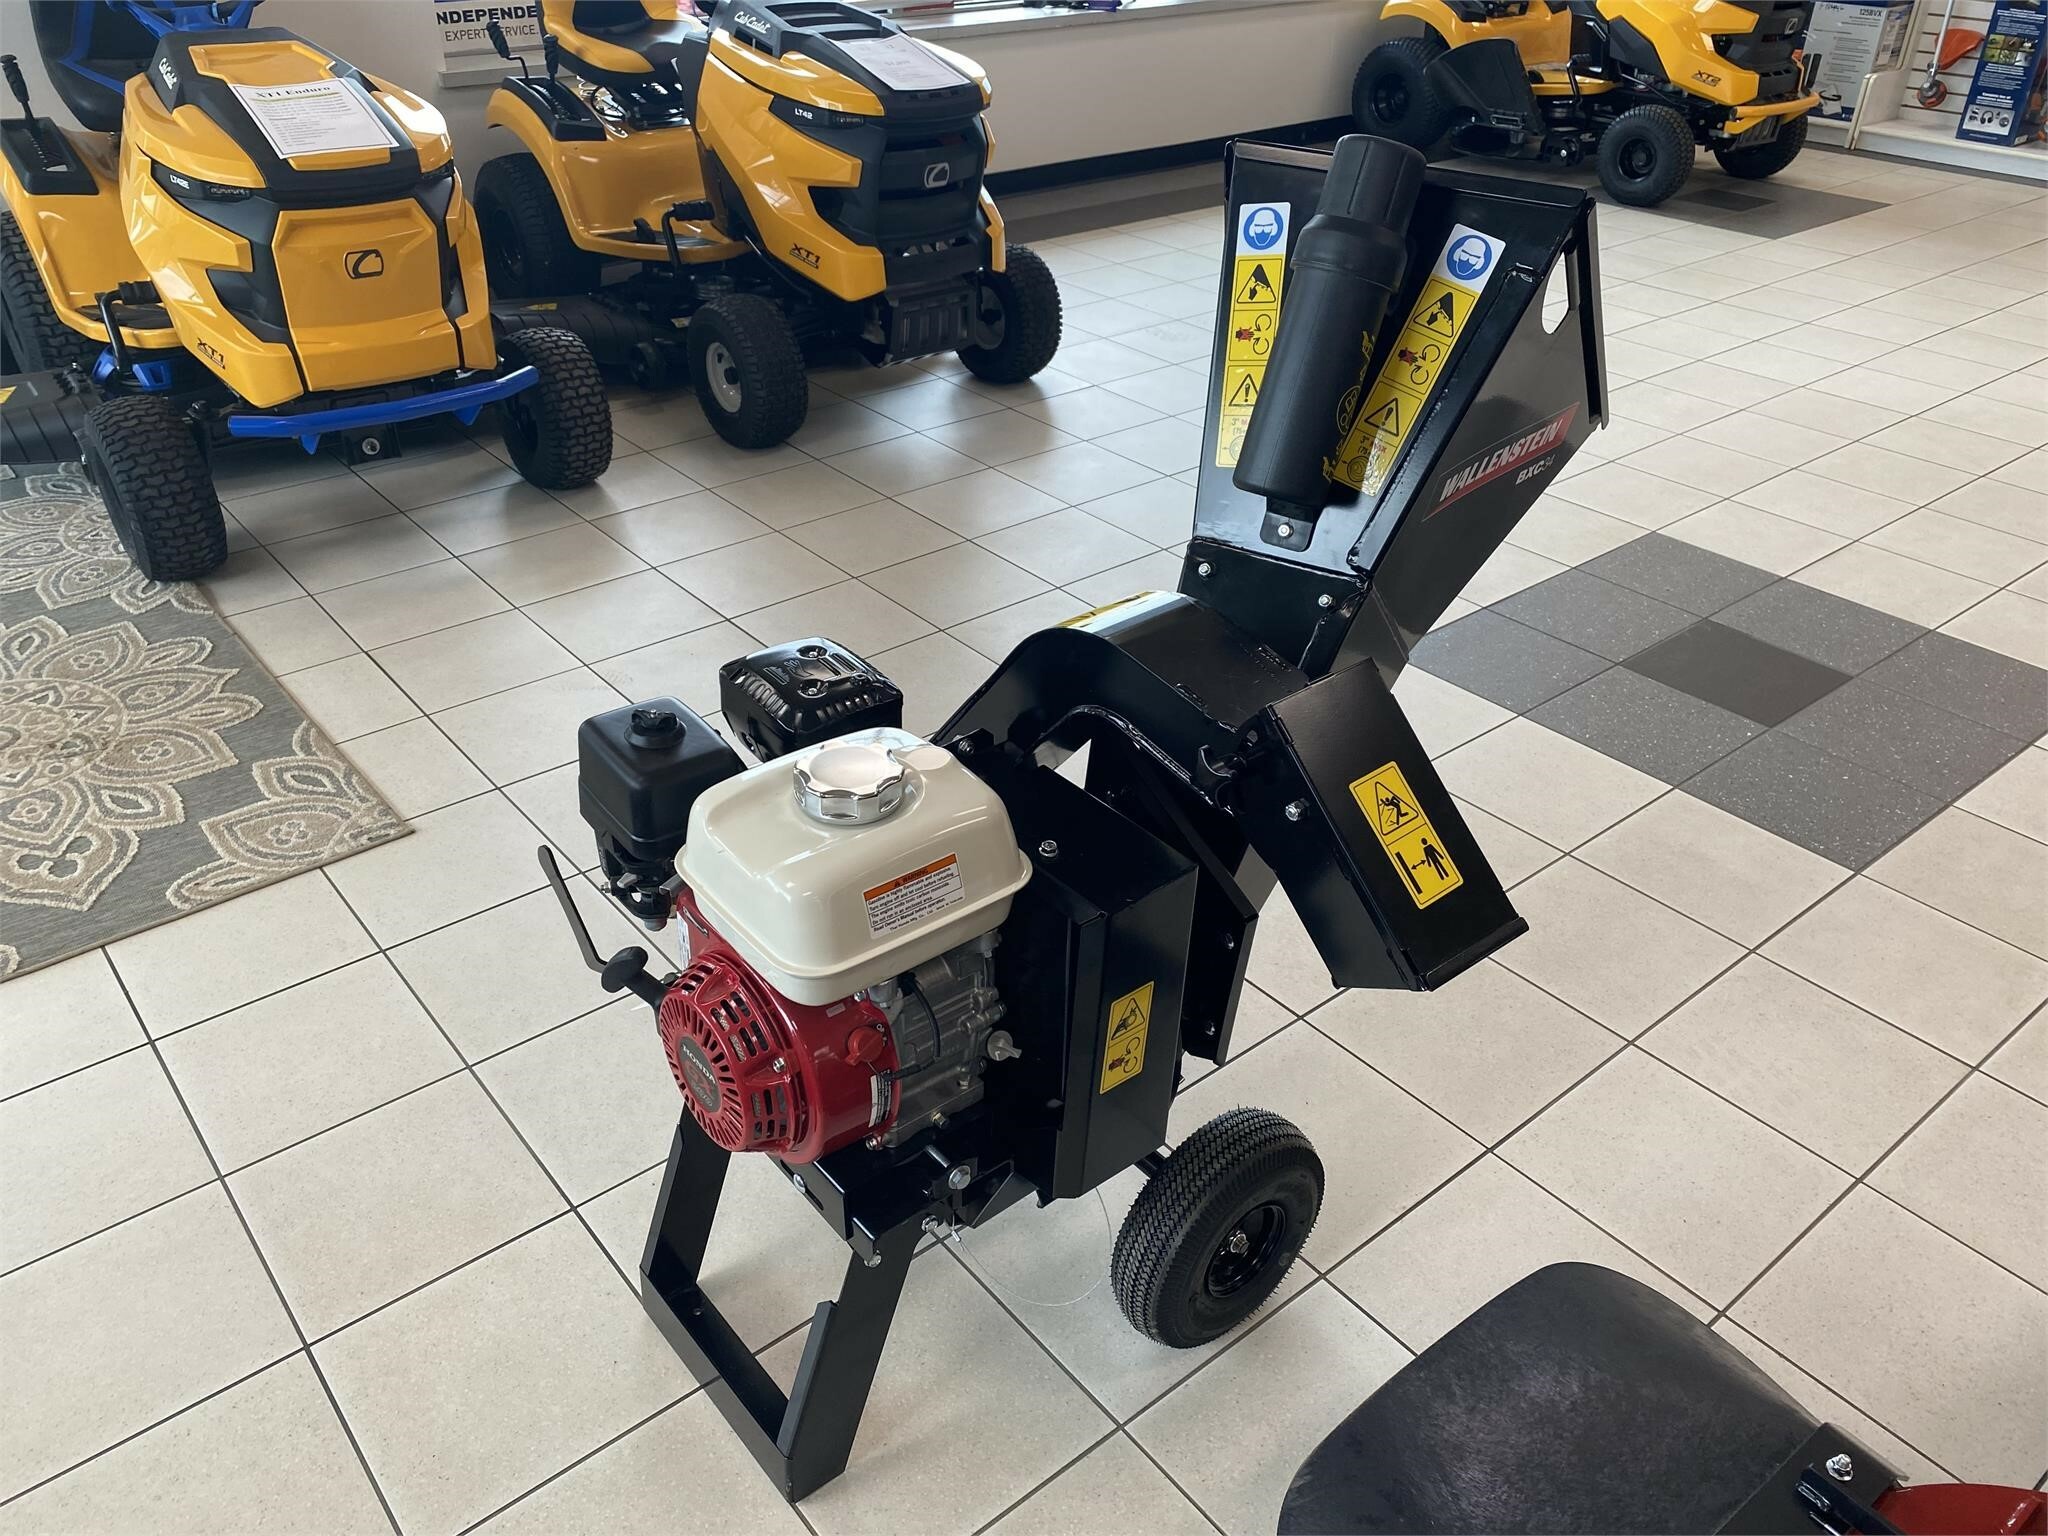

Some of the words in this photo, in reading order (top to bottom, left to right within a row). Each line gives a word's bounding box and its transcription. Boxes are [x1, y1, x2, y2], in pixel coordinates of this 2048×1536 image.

[445, 28, 486, 41] EXPERT
[1439, 419, 1563, 502] WALLENSTEIN
[903, 868, 929, 882] WARNING
[879, 898, 893, 907] engine
[879, 907, 893, 915] engine
[682, 1043, 716, 1084] HONDA
